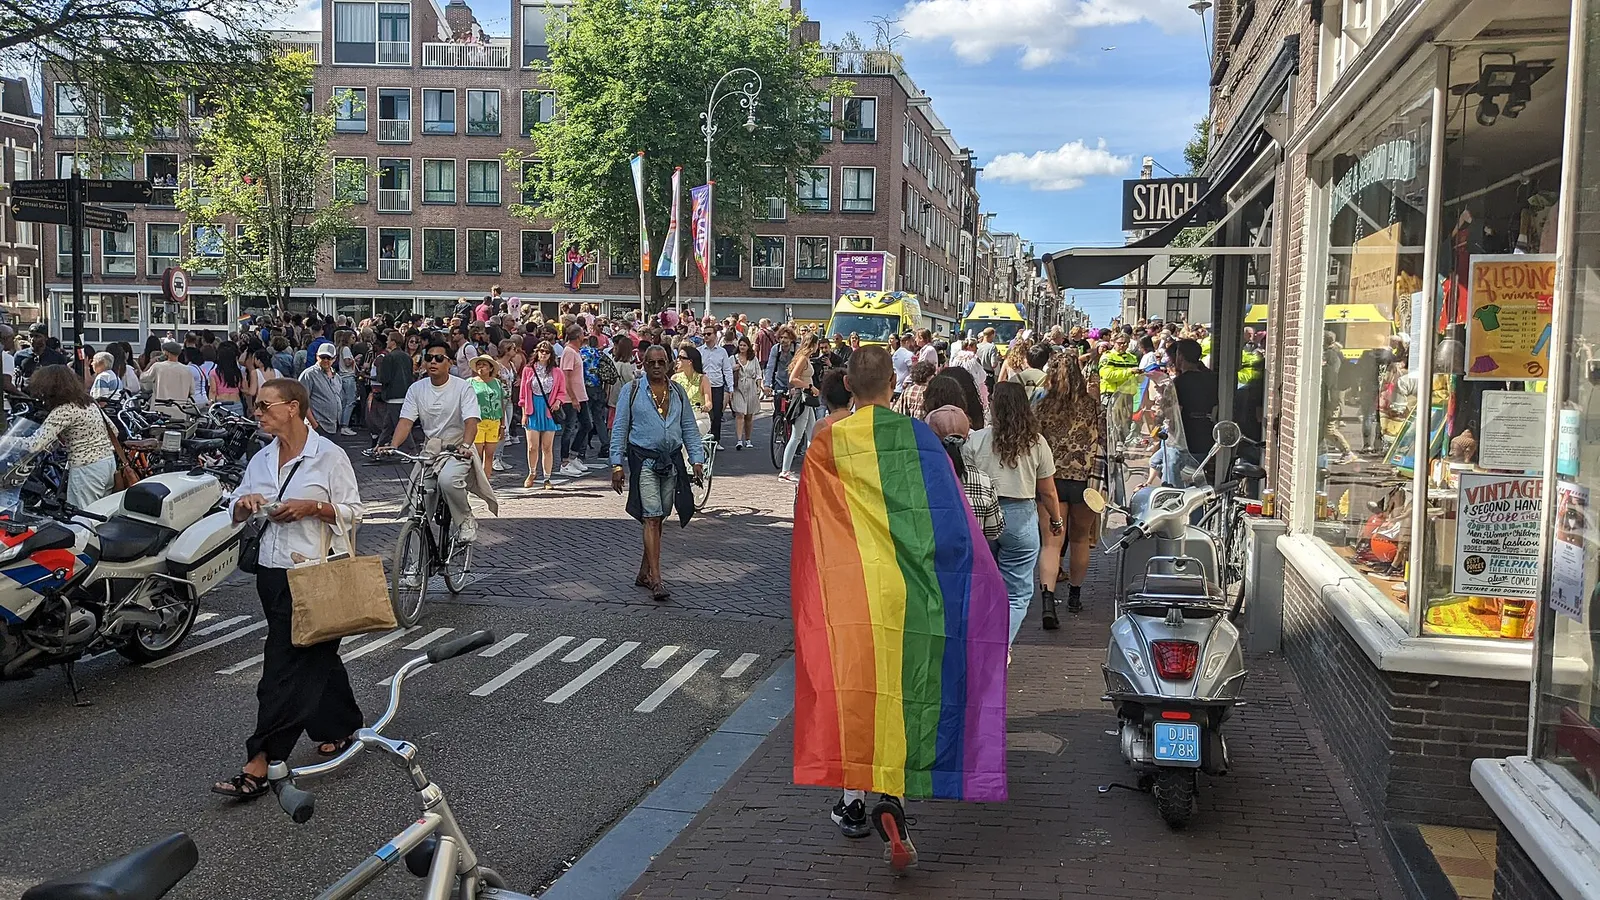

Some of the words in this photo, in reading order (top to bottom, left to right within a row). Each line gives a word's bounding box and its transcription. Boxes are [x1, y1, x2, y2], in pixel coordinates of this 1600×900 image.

[1133, 183, 1198, 220] STACH
[1464, 480, 1543, 505] VINTAGE
[1469, 500, 1510, 516] SECOND
[201, 556, 233, 582] POLITIE
[1169, 727, 1194, 741] DJH
[1169, 743, 1194, 757] 78R
